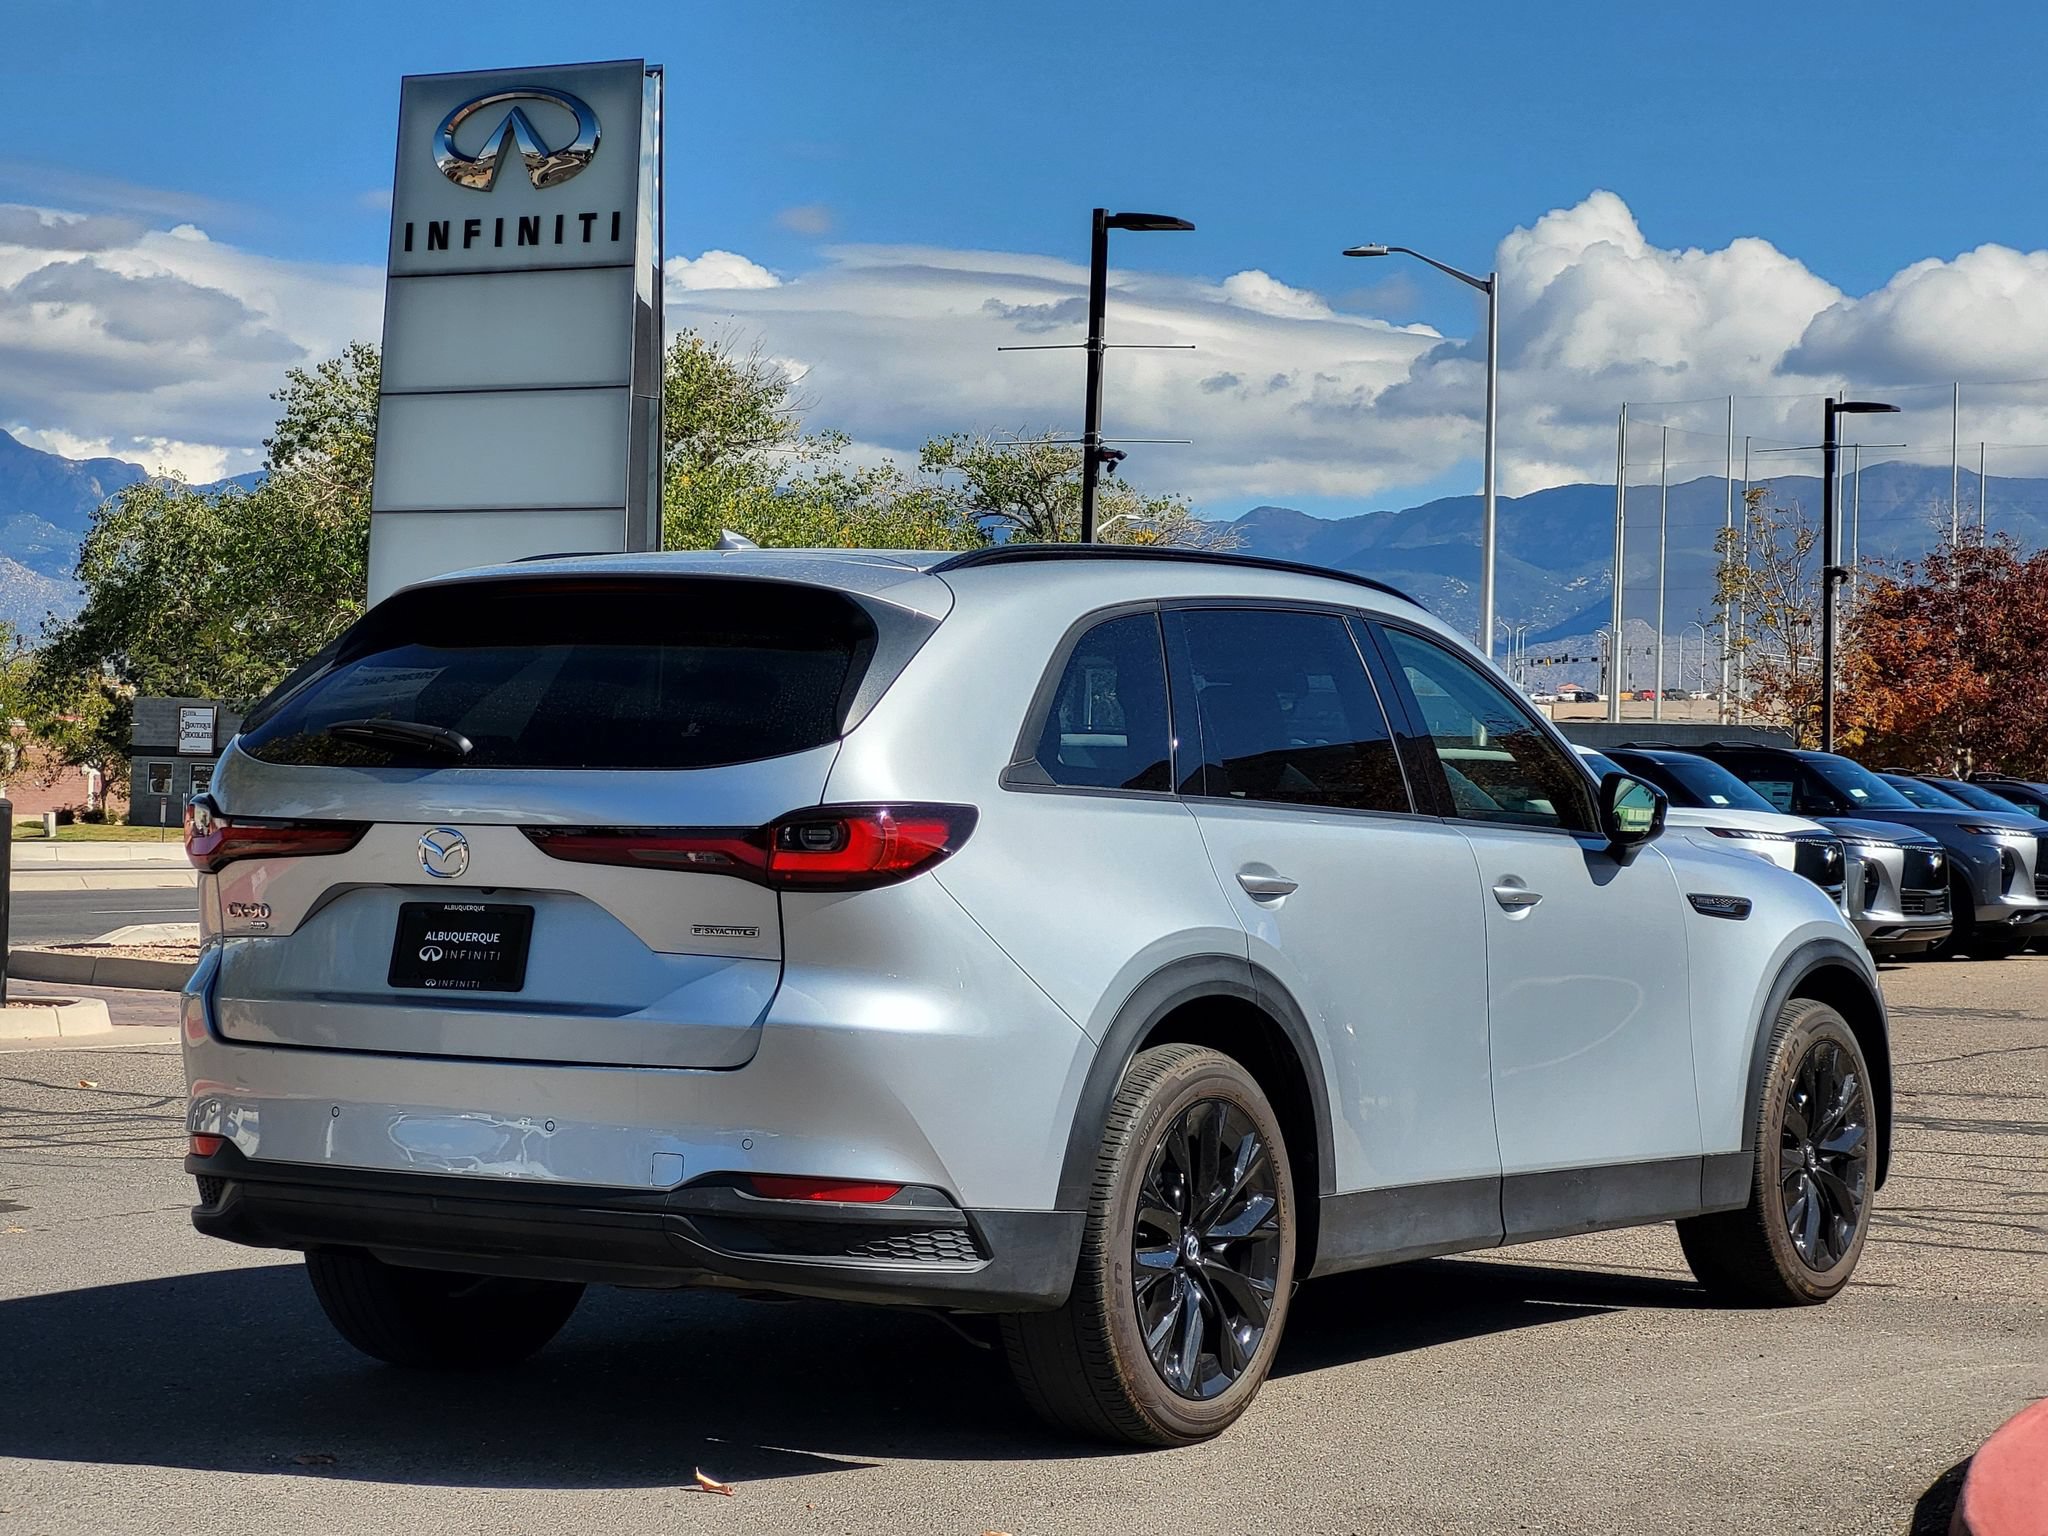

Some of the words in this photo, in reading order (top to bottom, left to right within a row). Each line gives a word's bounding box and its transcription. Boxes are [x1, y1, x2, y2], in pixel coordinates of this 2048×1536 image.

[404, 211, 621, 252] INFINITI
[227, 902, 271, 919] CX-90
[443, 904, 486, 912] ALBUQUERQUE
[424, 931, 501, 945] ALBUQUERQUE
[444, 950, 501, 961] INFINITI
[438, 979, 480, 988] INFINITI
[1139, 1103, 1162, 1146] OUTSIDE
